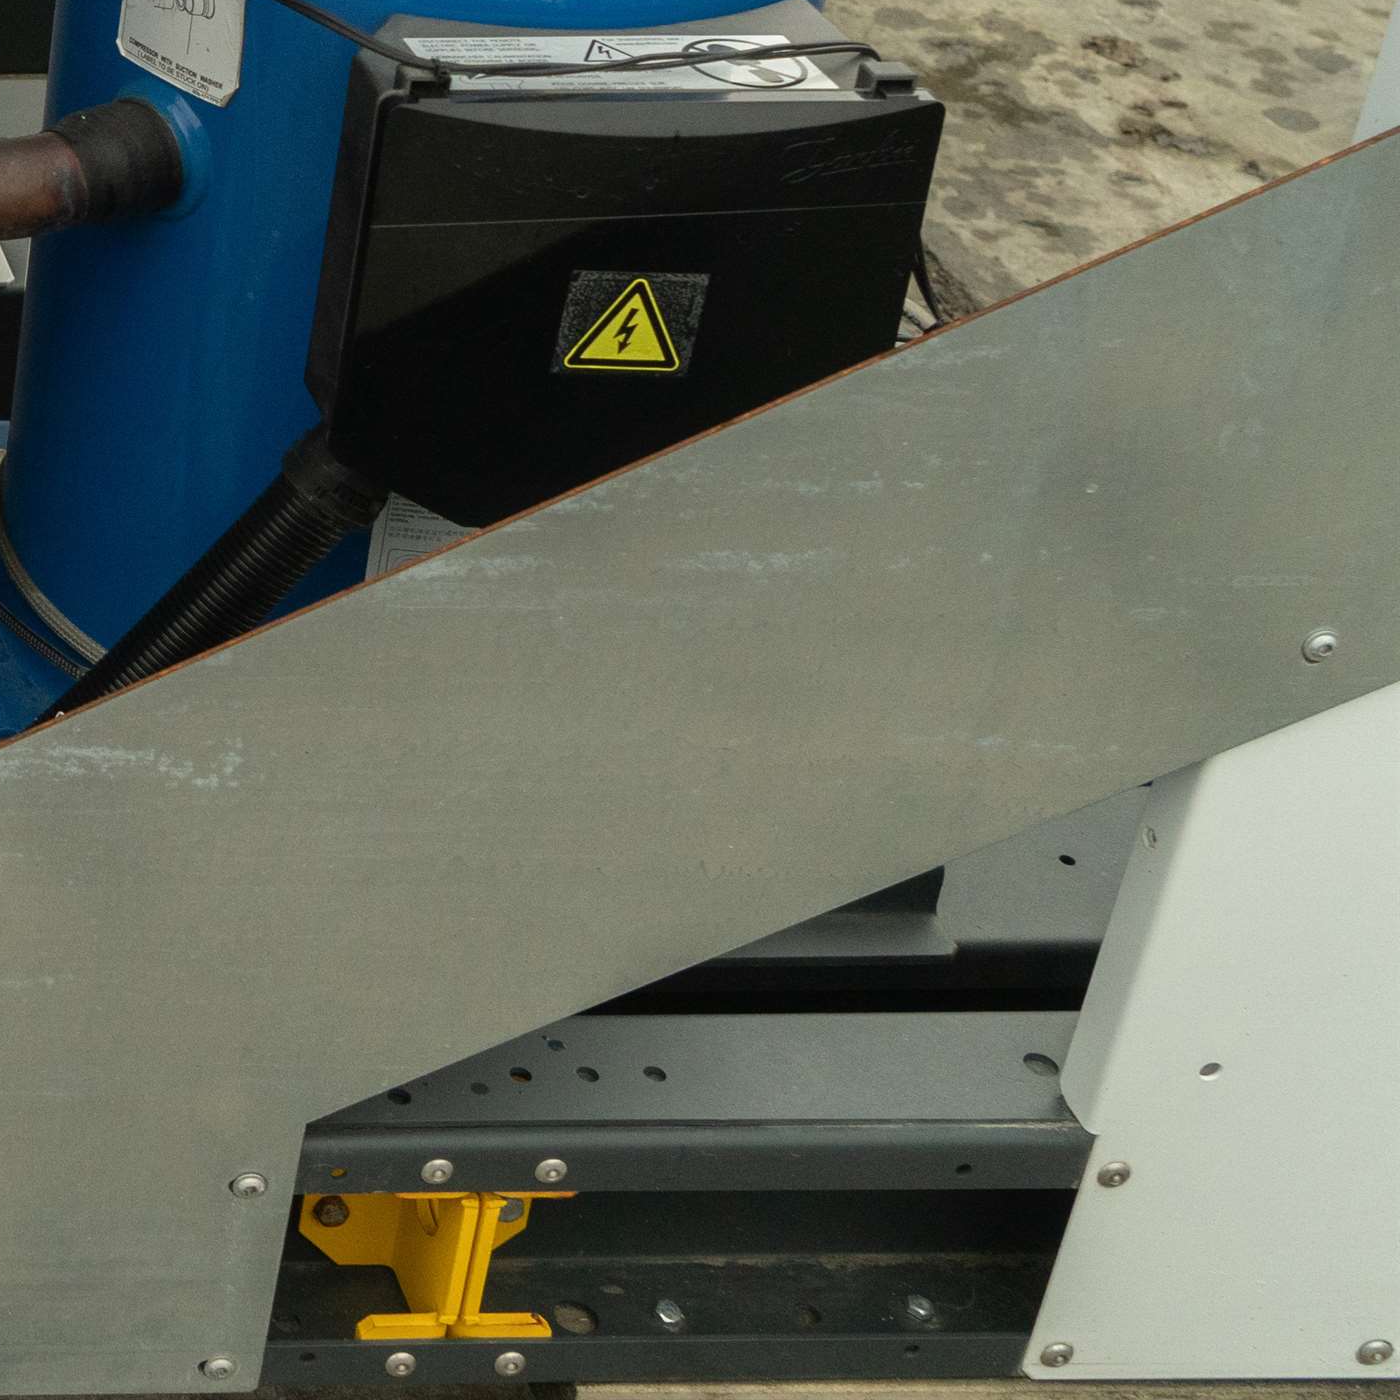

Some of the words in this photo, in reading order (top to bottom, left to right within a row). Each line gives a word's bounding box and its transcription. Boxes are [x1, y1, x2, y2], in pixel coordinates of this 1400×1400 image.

[128, 36, 159, 59] COMPRESSOR
[160, 55, 173, 66] WITH
[175, 63, 198, 79] SUCTION
[200, 75, 223, 89] WASHER
[175, 71, 196, 86] STUCK
